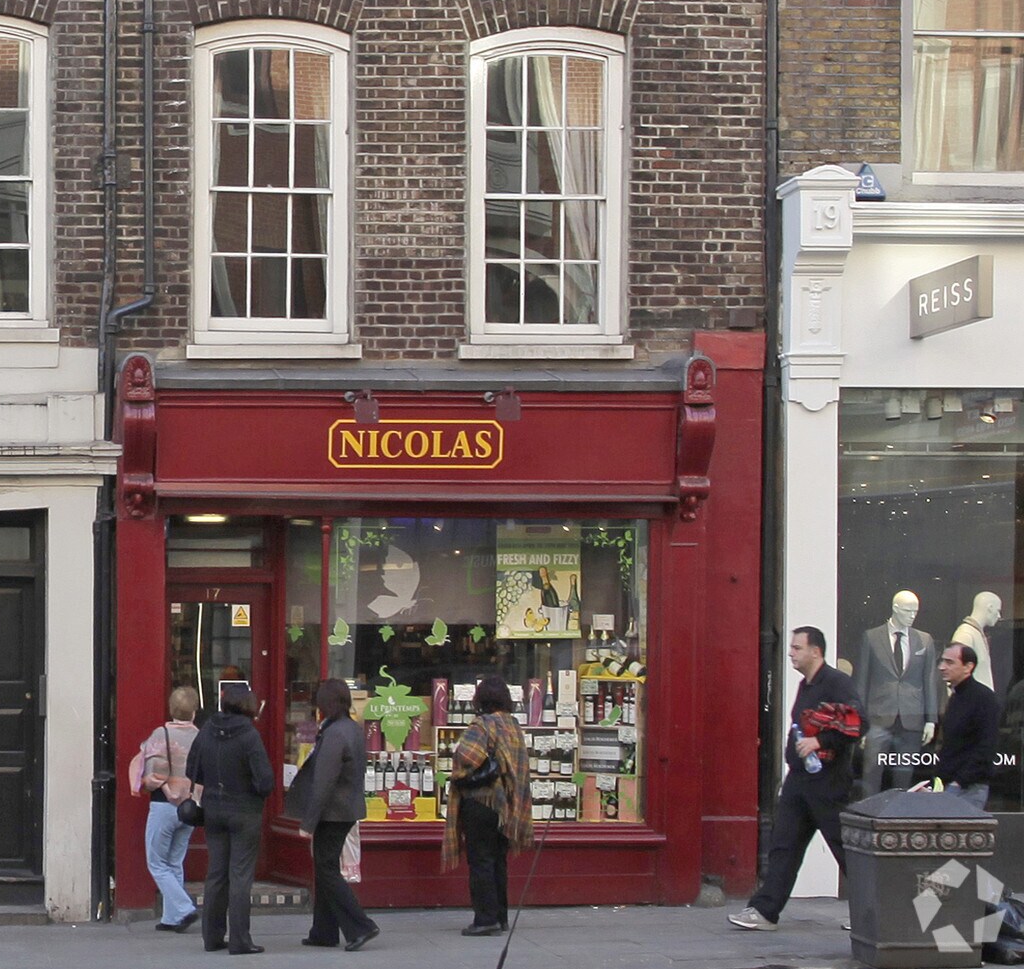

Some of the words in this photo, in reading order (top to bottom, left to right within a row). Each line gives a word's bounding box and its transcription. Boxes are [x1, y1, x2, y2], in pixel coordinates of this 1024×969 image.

[814, 205, 840, 231] 19
[919, 278, 973, 317] REISS
[339, 430, 493, 458] NICOLAS
[497, 554, 526, 565] FRESH
[529, 554, 550, 565] AND
[553, 553, 579, 565] FIZZY
[206, 588, 221, 600] 17
